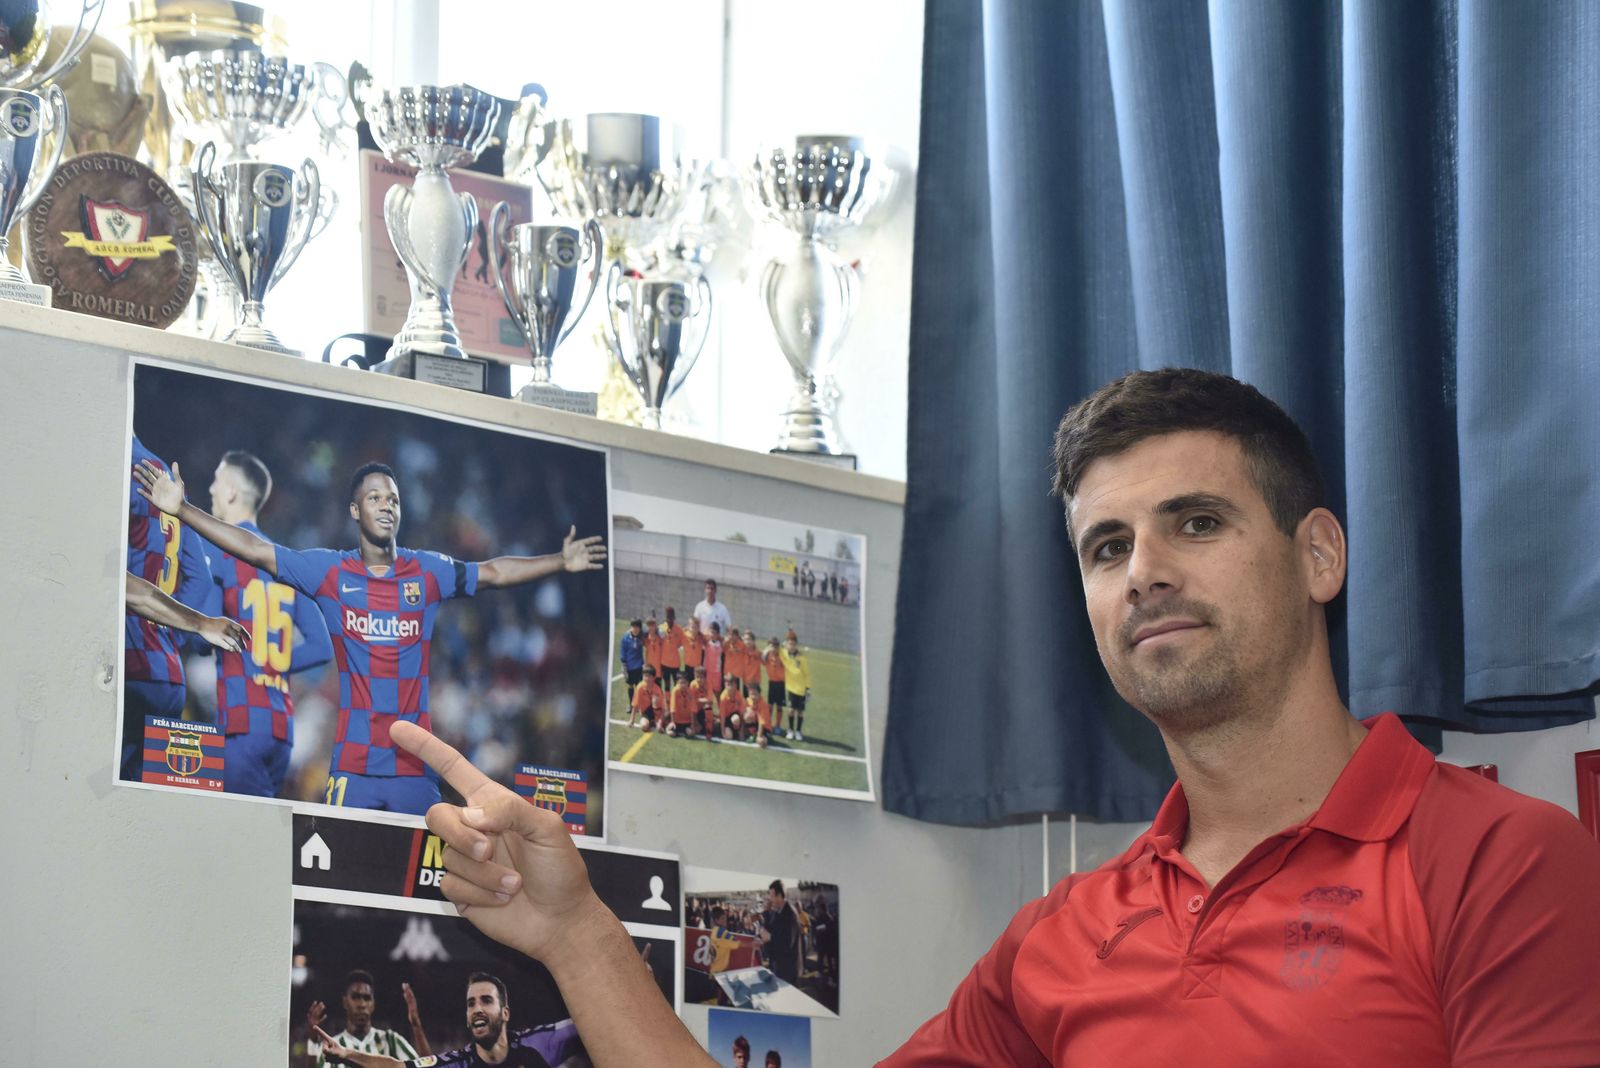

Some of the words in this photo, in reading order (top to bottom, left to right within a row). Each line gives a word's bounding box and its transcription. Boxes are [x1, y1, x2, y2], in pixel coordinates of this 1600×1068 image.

[54, 156, 139, 188] DEPORTIVA
[147, 177, 181, 217] CLUB
[161, 226, 194, 317] DEPORTIVO
[72, 291, 159, 323] ROMERAL
[242, 578, 296, 673] 15
[346, 609, 419, 638] Rakuten
[152, 718, 170, 728] PEÑA
[170, 721, 218, 734] BARCELONISTA
[522, 765, 538, 775] PEÑA
[538, 768, 581, 781] BARCELONISTA
[422, 834, 449, 869] M
[418, 867, 448, 887] DE
